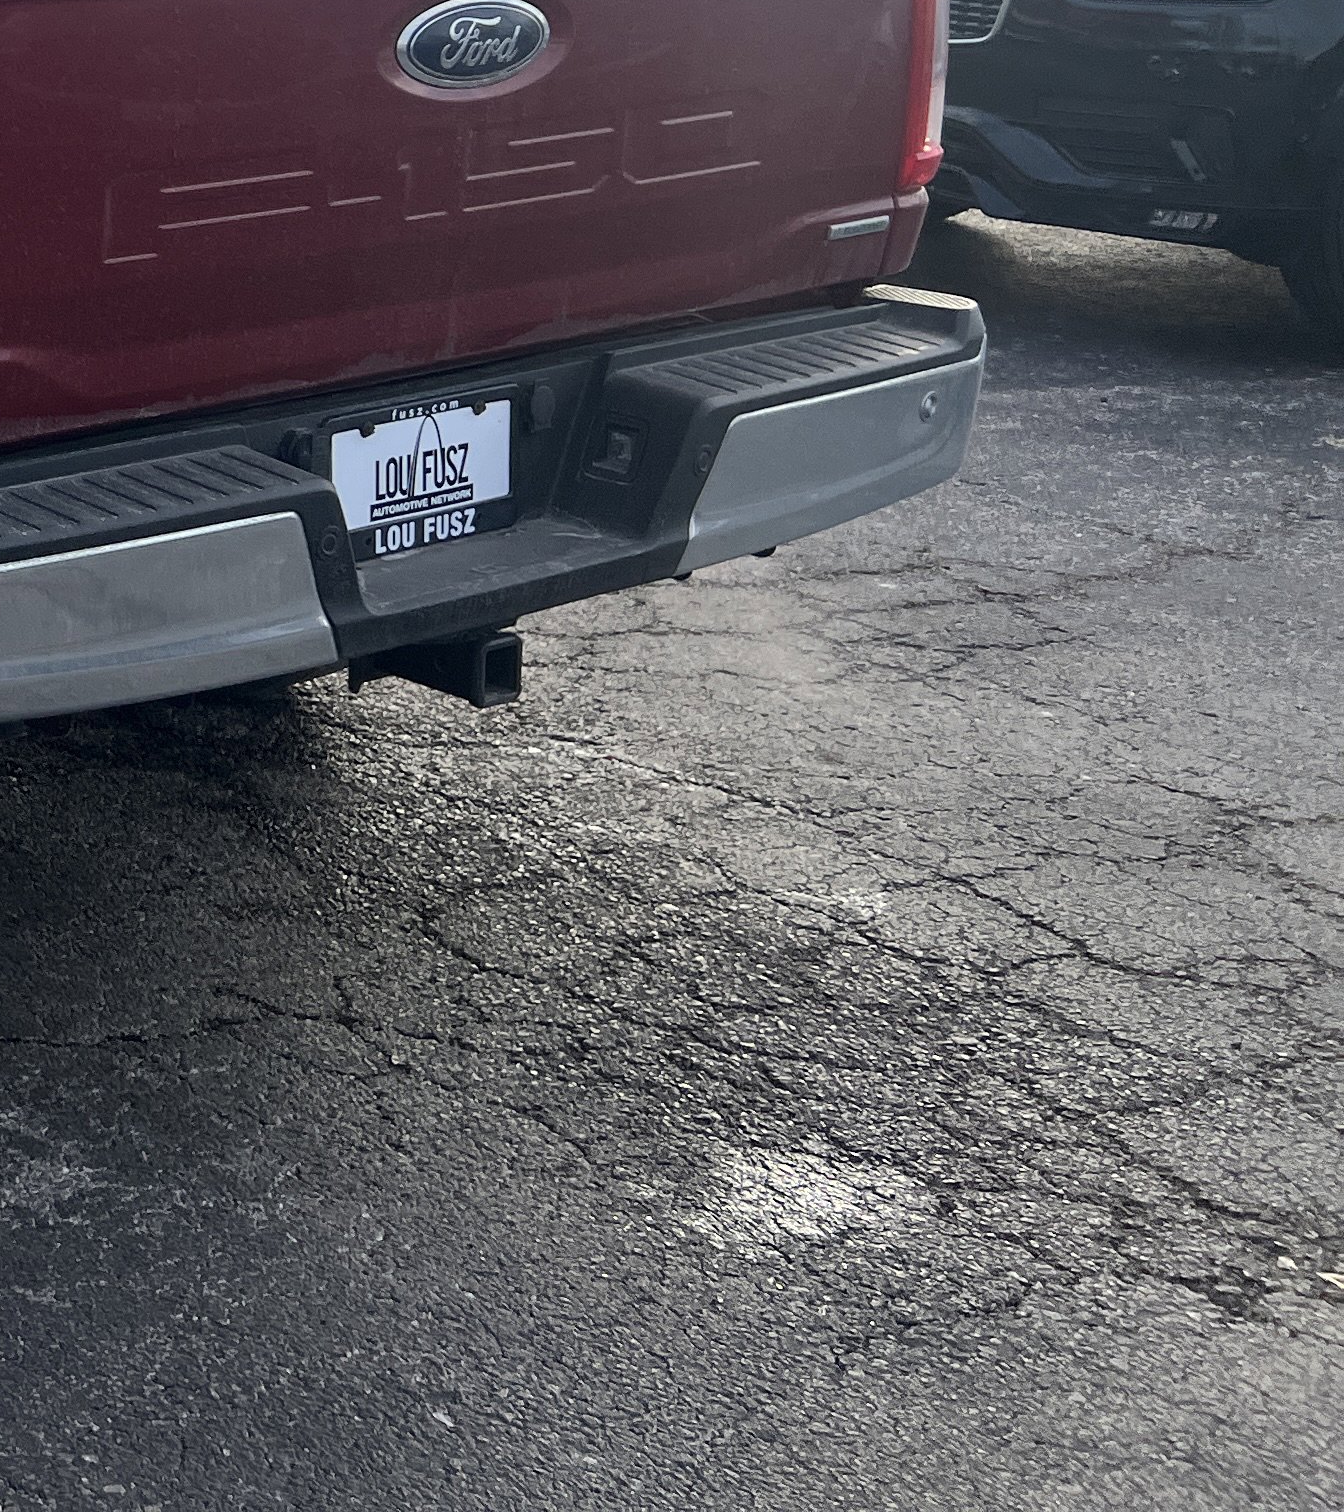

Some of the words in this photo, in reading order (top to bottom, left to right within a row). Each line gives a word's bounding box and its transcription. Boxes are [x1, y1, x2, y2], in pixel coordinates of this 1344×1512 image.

[440, 16, 522, 70] Ford
[391, 399, 459, 421] fusz.com
[375, 454, 412, 501] LOU
[422, 443, 469, 492] FUSZ
[372, 497, 429, 518] AUTOMOTIVE
[431, 488, 473, 506] NETWORK
[374, 521, 416, 555] LOU
[423, 508, 476, 543] FUSZ
